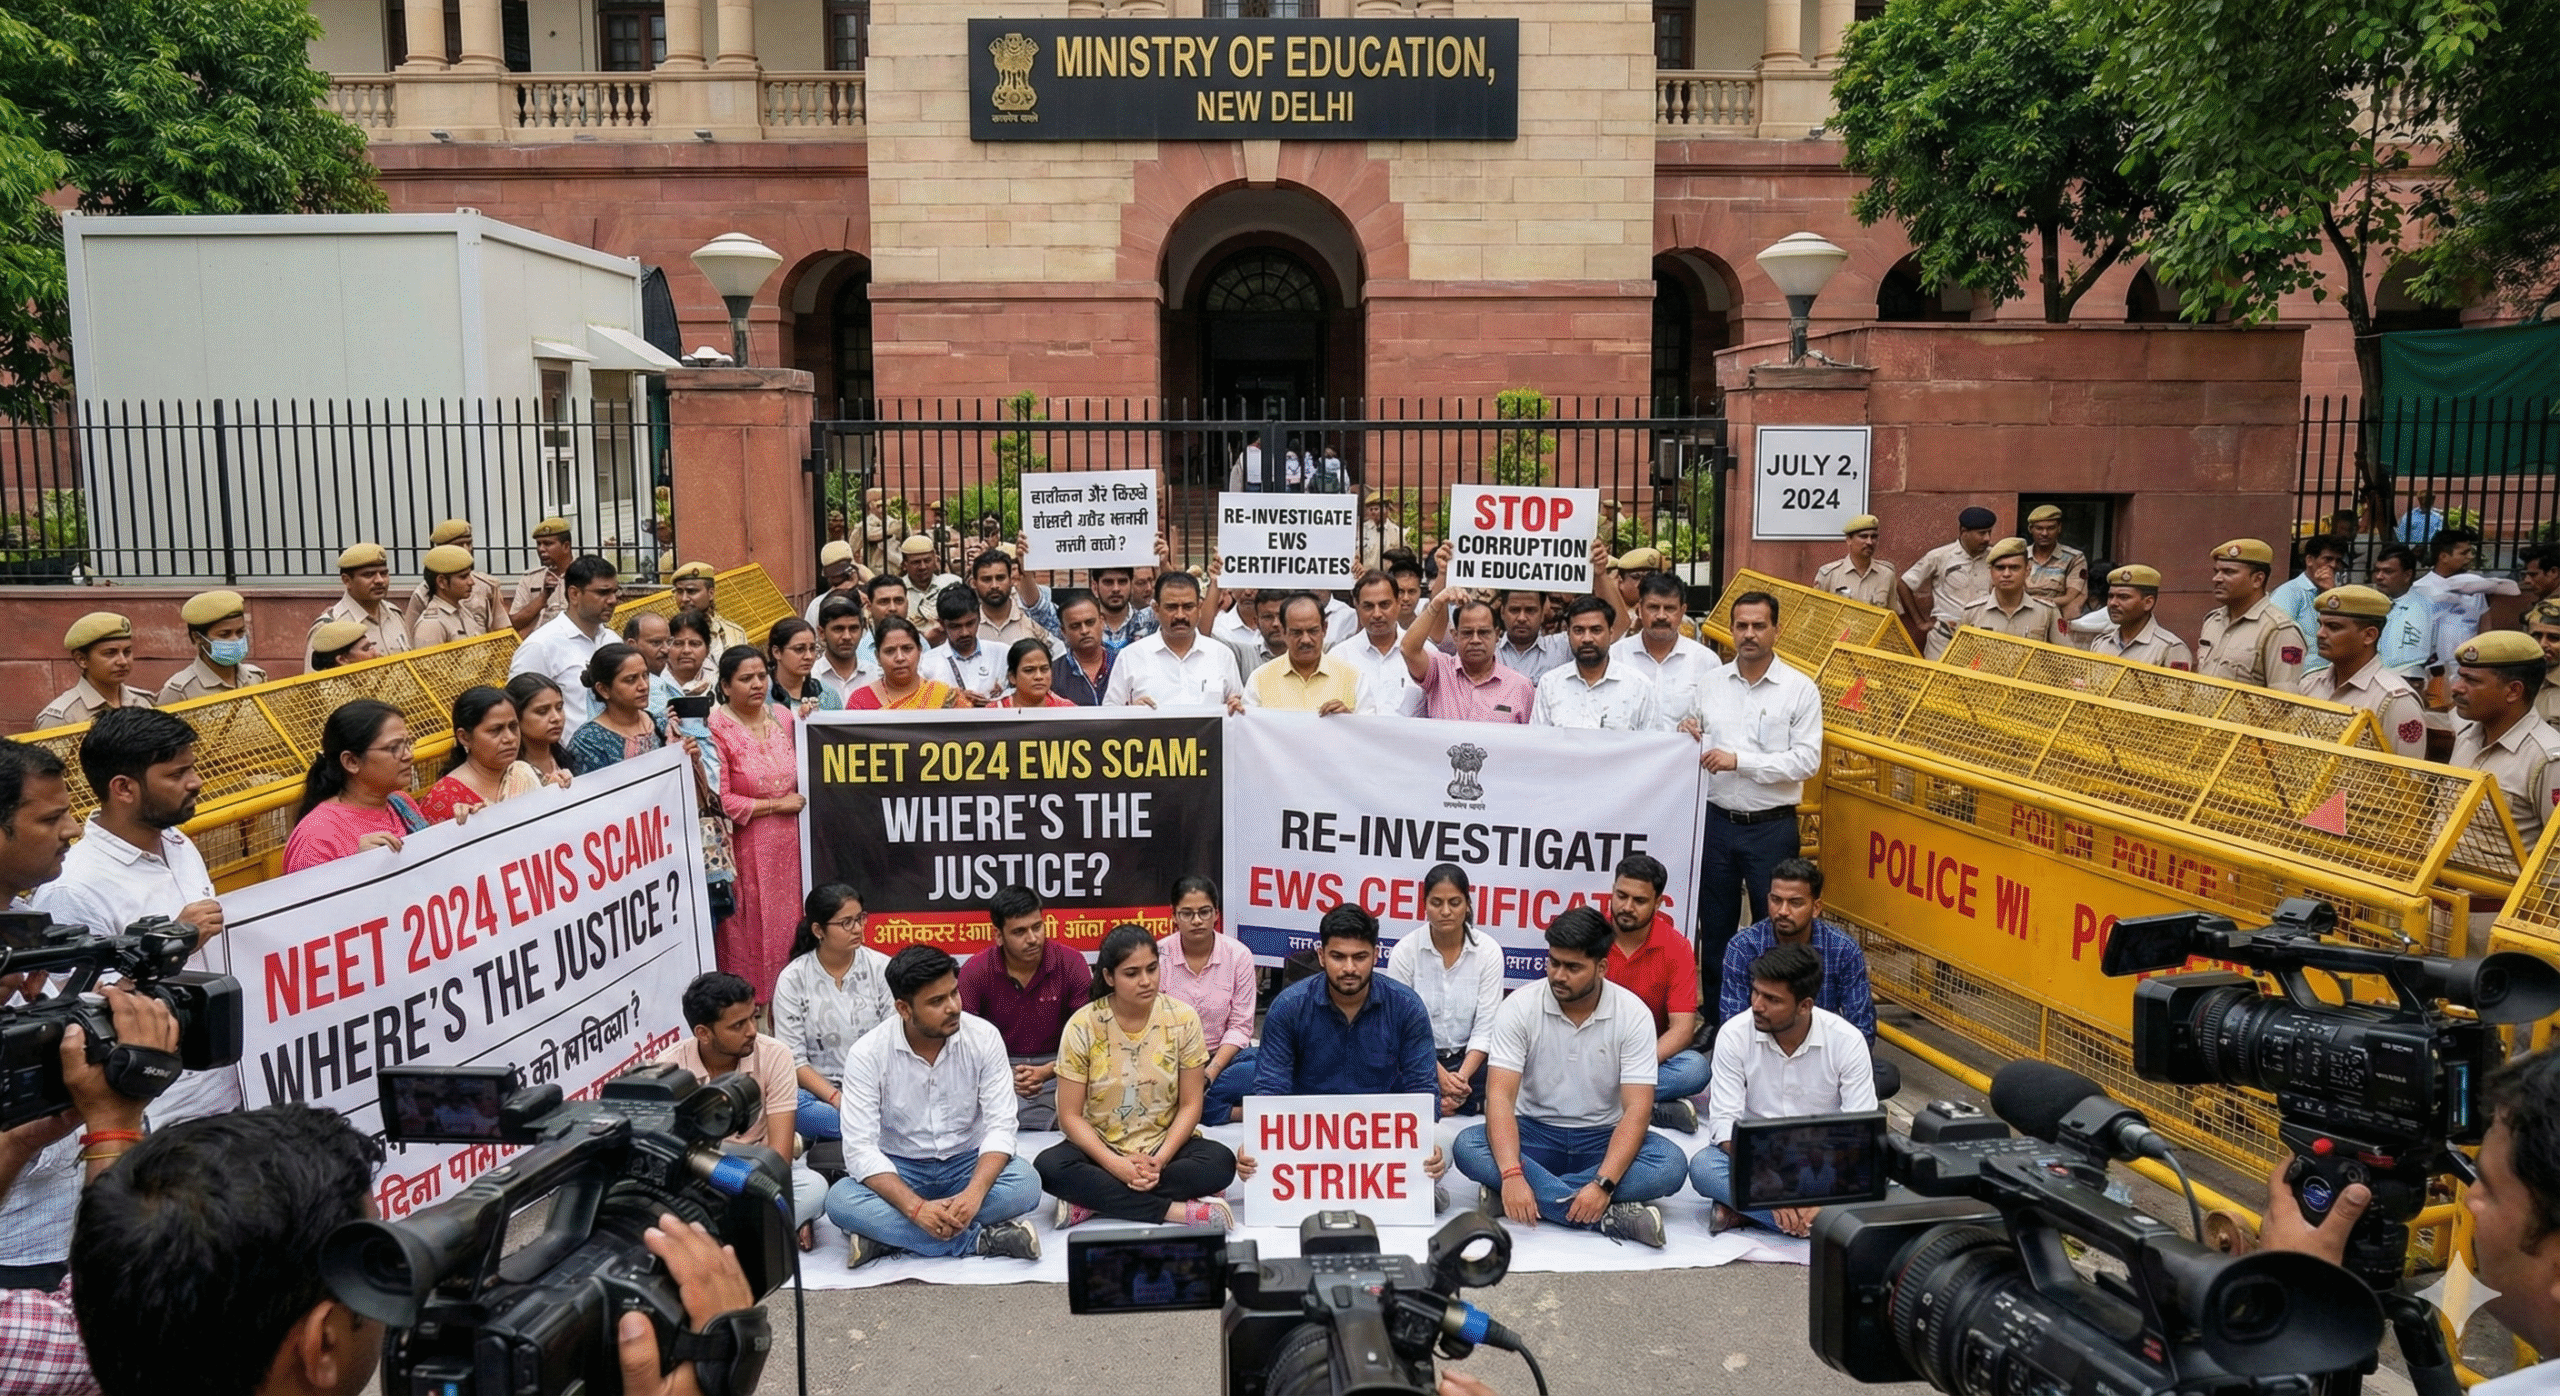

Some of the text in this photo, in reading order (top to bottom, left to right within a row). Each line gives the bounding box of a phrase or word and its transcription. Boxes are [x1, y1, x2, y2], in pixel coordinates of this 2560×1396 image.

[1056, 36, 1496, 85] MINISTRY OF EDUCATION,
[1197, 91, 1353, 122] NEW DELHI
[1766, 454, 1858, 480] JULY 2,
[1224, 508, 1353, 526] RE-INVESTIGATE
[1474, 494, 1574, 532] STOP
[1781, 488, 1840, 509] 2024
[1268, 532, 1307, 550] EWS
[1458, 534, 1587, 558] CORRUPTION
[1224, 555, 1350, 575] CERTIFICATES
[1456, 560, 1587, 582] IN EDUCATION
[822, 737, 1209, 783] NEET 2024 EWS SCAM:
[881, 791, 1153, 843] WHERE'S THE
[928, 852, 1111, 901] JUSTICE?
[1249, 866, 1344, 913] EWS
[1868, 830, 1979, 920] POLICE
[1996, 874, 2031, 942] WI
[263, 804, 674, 1024] NEET 2024 EWS SCAM:
[472, 938, 546, 1026] THE
[553, 879, 664, 992] JUSTICE
[1260, 1112, 1419, 1151] HUNGER
[1272, 1162, 1407, 1201] STRIKE
